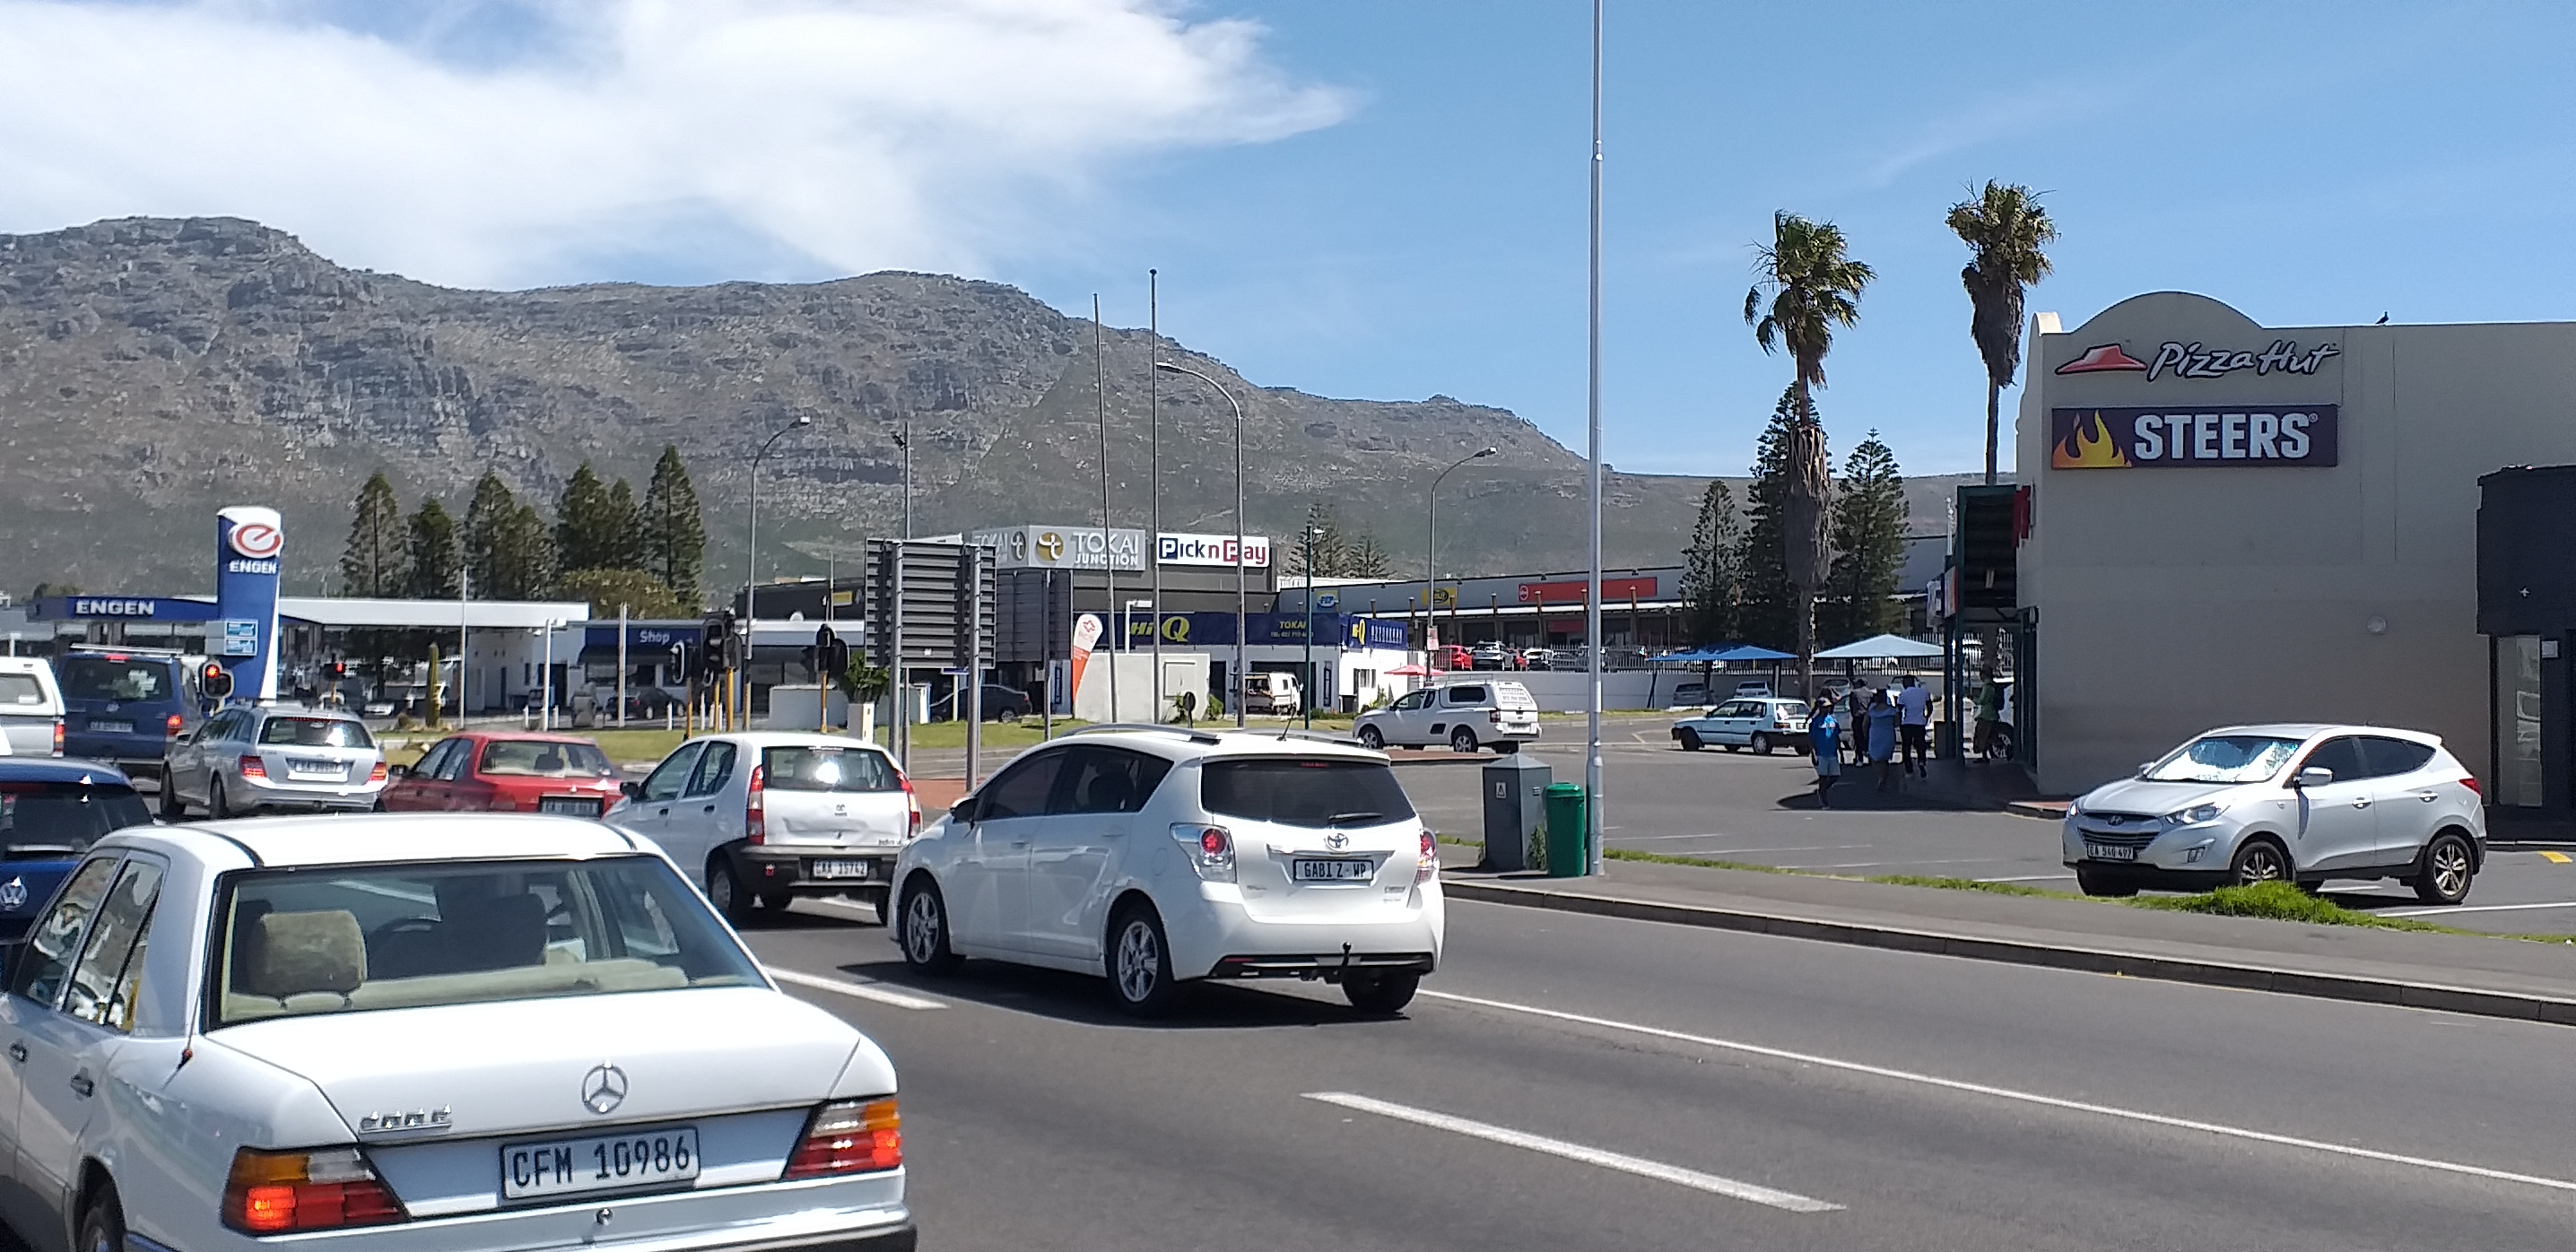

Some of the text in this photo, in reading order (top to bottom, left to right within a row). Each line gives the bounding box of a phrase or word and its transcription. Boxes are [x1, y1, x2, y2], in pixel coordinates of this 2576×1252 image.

[2147, 340, 2340, 382] Pizza Hut
[2135, 413, 2310, 459] STEERS
[1073, 532, 1139, 555] TOKAI
[1159, 537, 1266, 565] Pick n Pay
[230, 560, 277, 574] ENGEN
[1075, 553, 1138, 566] JUNCTION
[75, 600, 154, 616] ENGEN
[1279, 620, 1307, 629] TOKAI
[640, 630, 670, 645] Shop
[1304, 863, 1333, 878] GABI
[1353, 863, 1367, 878] WP
[513, 1135, 690, 1187] CFM 10986
